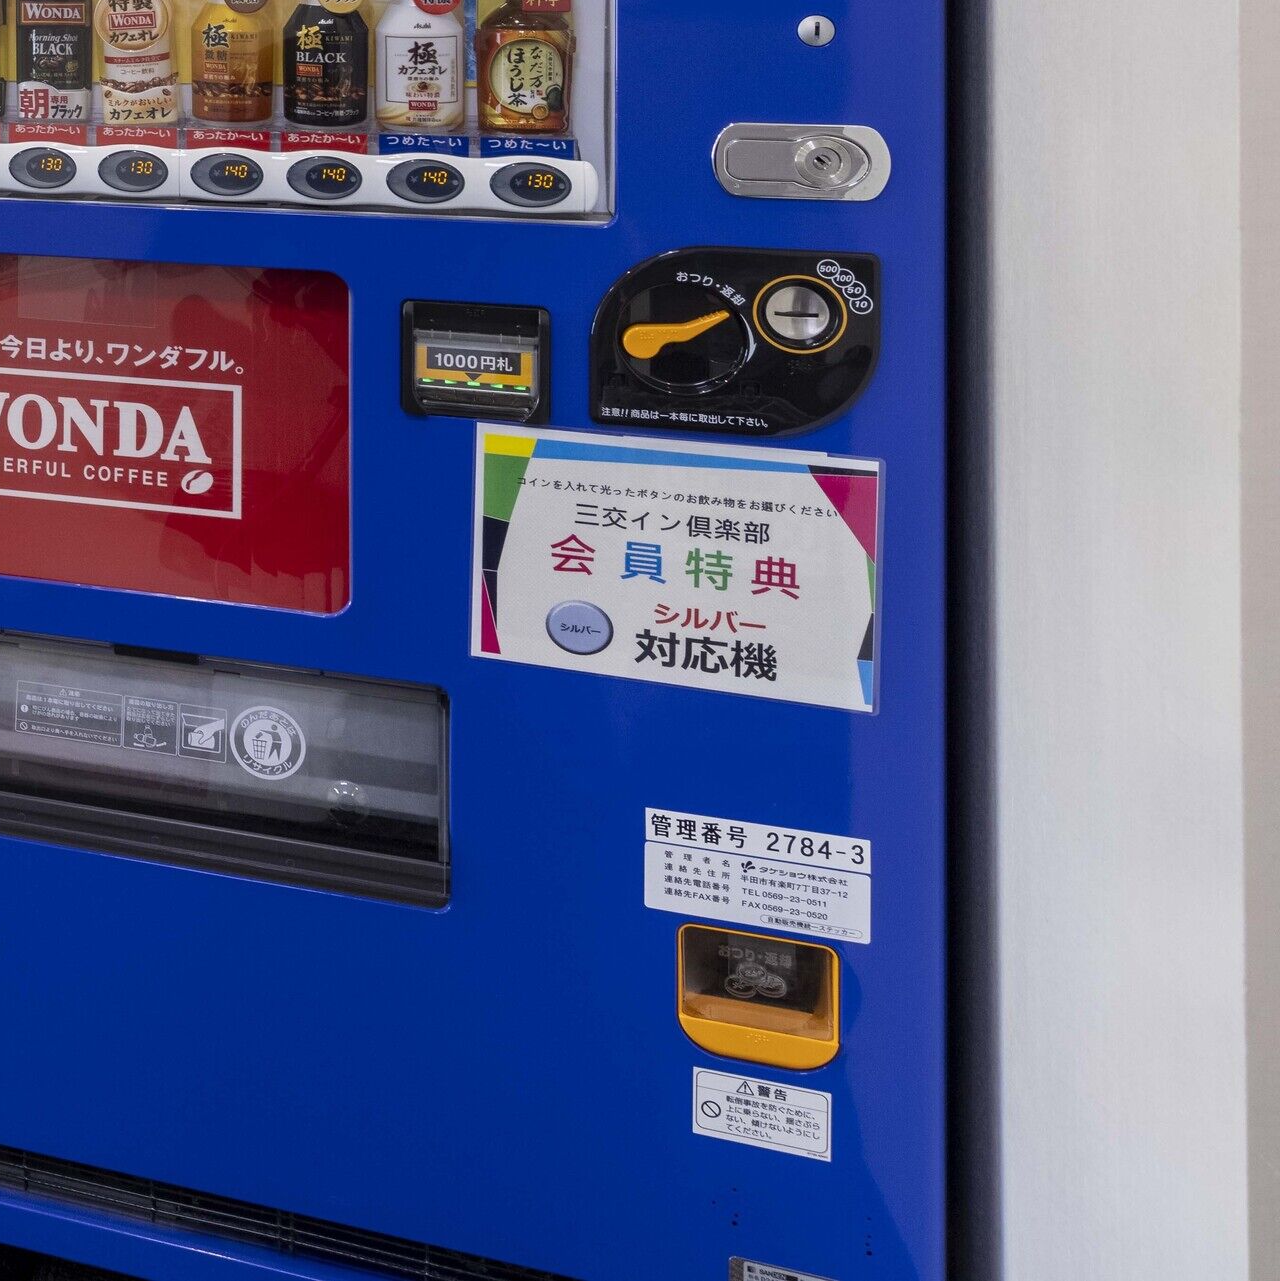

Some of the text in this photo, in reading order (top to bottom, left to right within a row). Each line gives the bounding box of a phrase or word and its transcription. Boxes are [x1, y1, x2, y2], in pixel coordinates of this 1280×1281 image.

[24, 3, 80, 19] WONDA
[112, 13, 152, 27] WONDA
[109, 30, 159, 43] カフェオレ
[203, 23, 229, 48] 極
[296, 25, 324, 50] 極
[296, 52, 346, 63] BLACK
[407, 41, 439, 65] 極
[398, 65, 447, 75] カフェオレ
[507, 48, 527, 107] ほうじ茶
[20, 89, 49, 119] 朝
[51, 105, 82, 119] ブラック
[109, 106, 172, 121] カフェオレ
[675, 270, 746, 306] おつり・返却
[434, 351, 514, 372] 1000円札
[84, 465, 169, 487] COFFEE
[516, 475, 839, 519] コインを入れて光ったボタンのお飲み物をお選びください
[573, 502, 771, 545] 三交イン倶楽部
[549, 532, 801, 601] 会員特典
[653, 601, 767, 634] シルバー
[633, 627, 778, 683] 対応機
[650, 812, 866, 866] 管理番号 2784-3
[664, 874, 731, 893] 連絡先電話番号
[664, 887, 731, 905] 連絡先FAX番号
[727, 1123, 772, 1139] てください。
